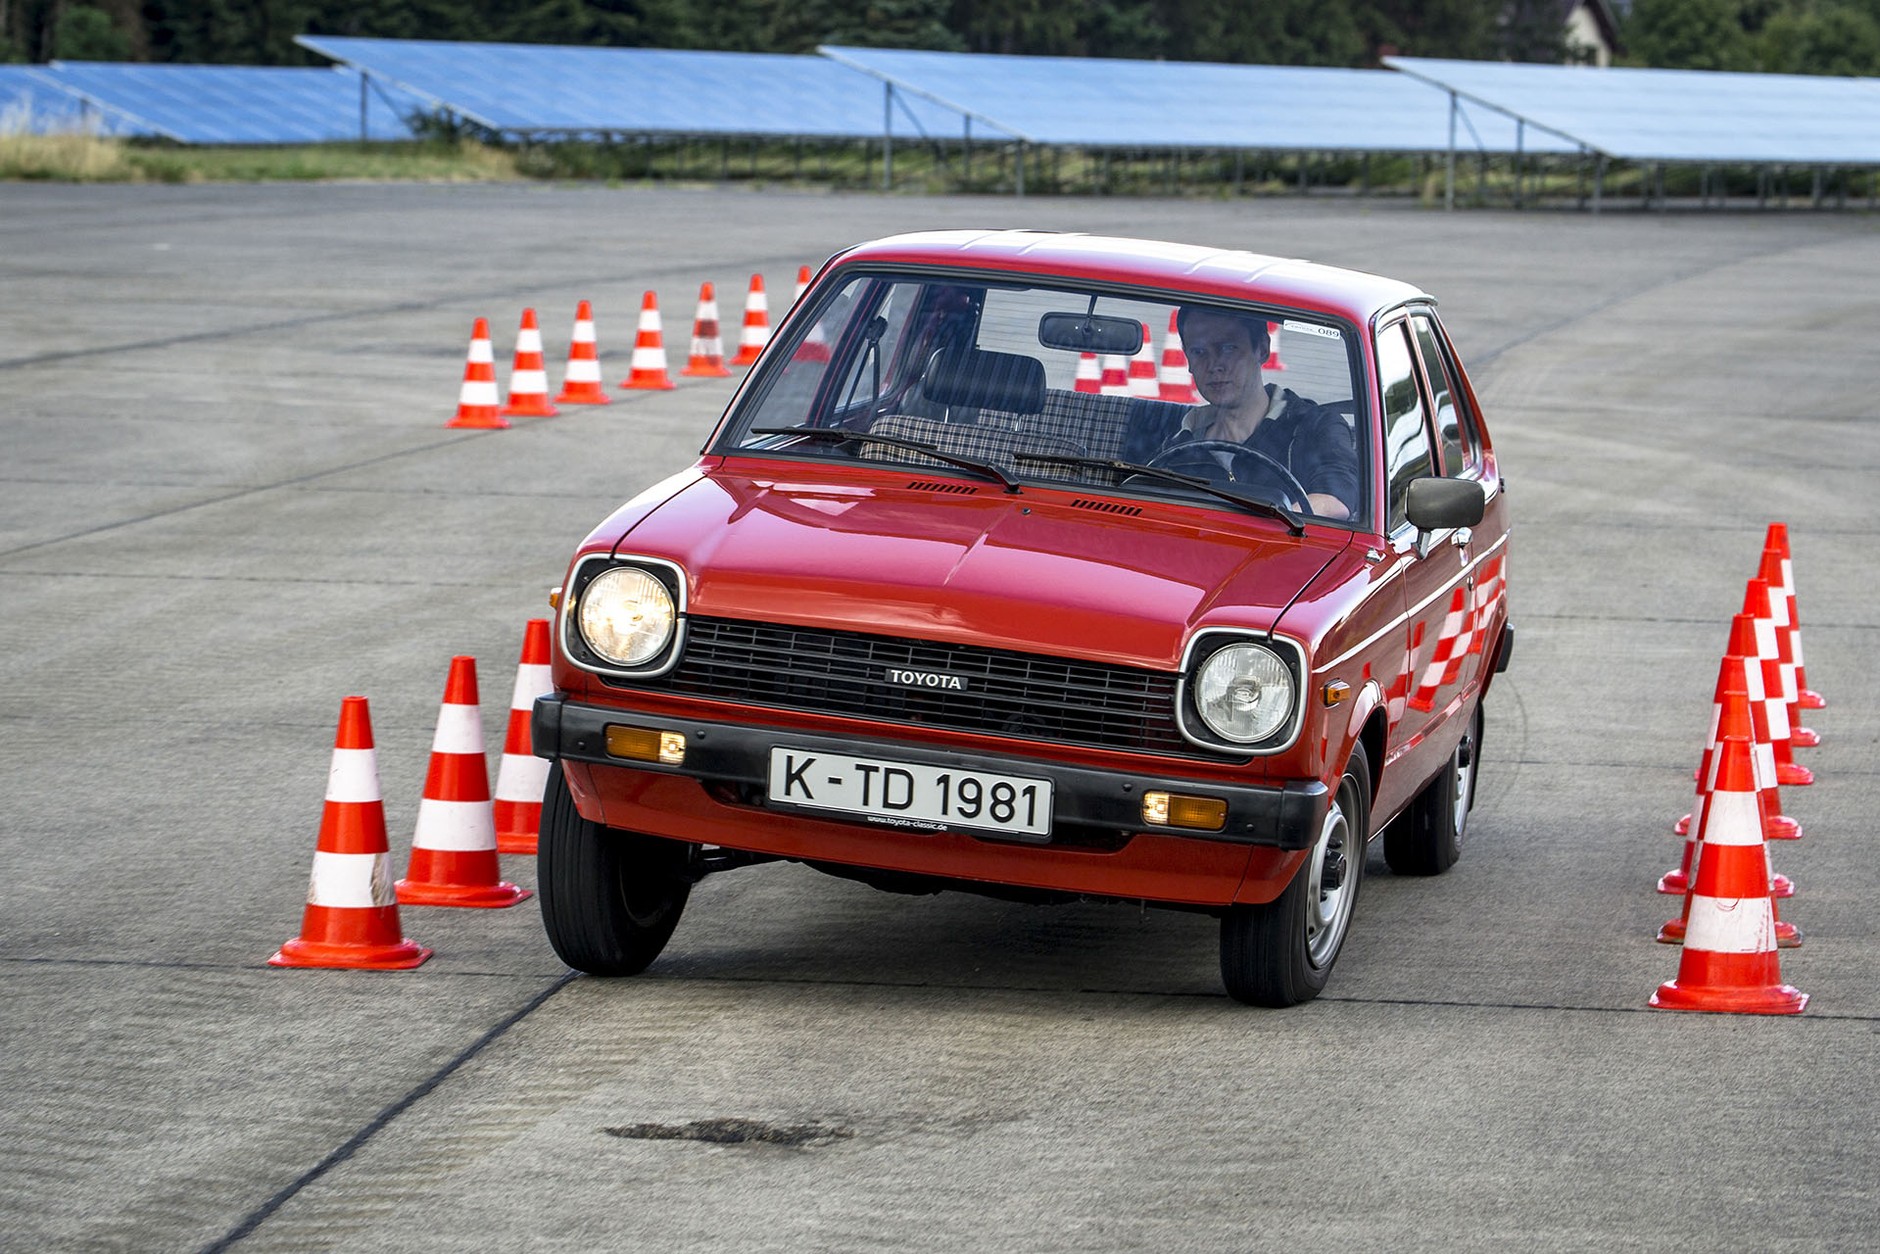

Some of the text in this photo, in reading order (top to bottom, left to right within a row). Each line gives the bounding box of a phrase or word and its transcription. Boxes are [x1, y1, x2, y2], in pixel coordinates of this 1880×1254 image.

[1317, 328, 1339, 338] 089
[891, 669, 962, 690] TOYOTA
[936, 773, 1037, 827] 1981
[866, 815, 948, 832] www.toyota-classic.de
